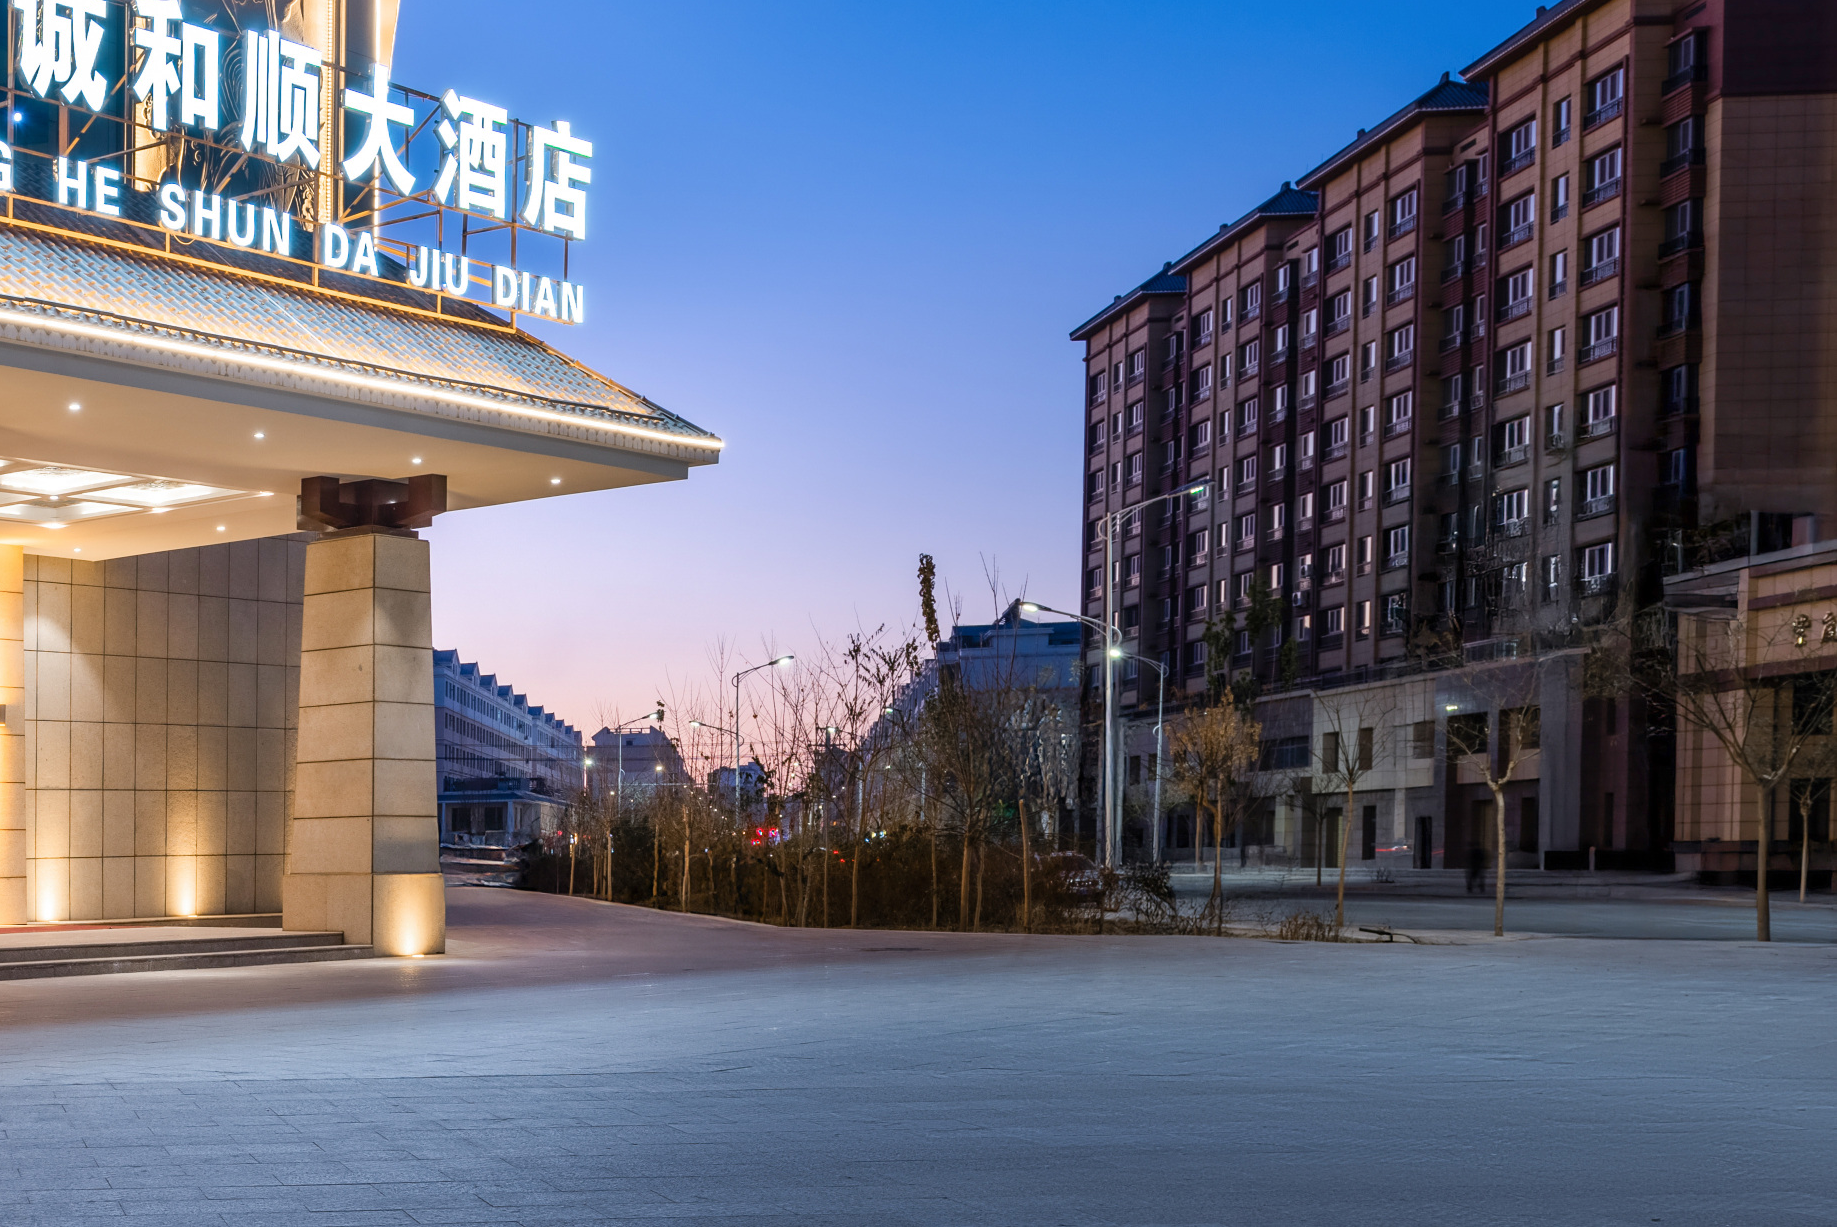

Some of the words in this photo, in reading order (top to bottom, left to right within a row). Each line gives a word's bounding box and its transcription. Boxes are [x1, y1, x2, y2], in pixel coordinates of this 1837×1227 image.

[54, 155, 122, 217] HE
[160, 182, 292, 257] SHUN
[323, 222, 380, 277] DA
[407, 244, 469, 296] JIU
[494, 264, 585, 324] DIAN
